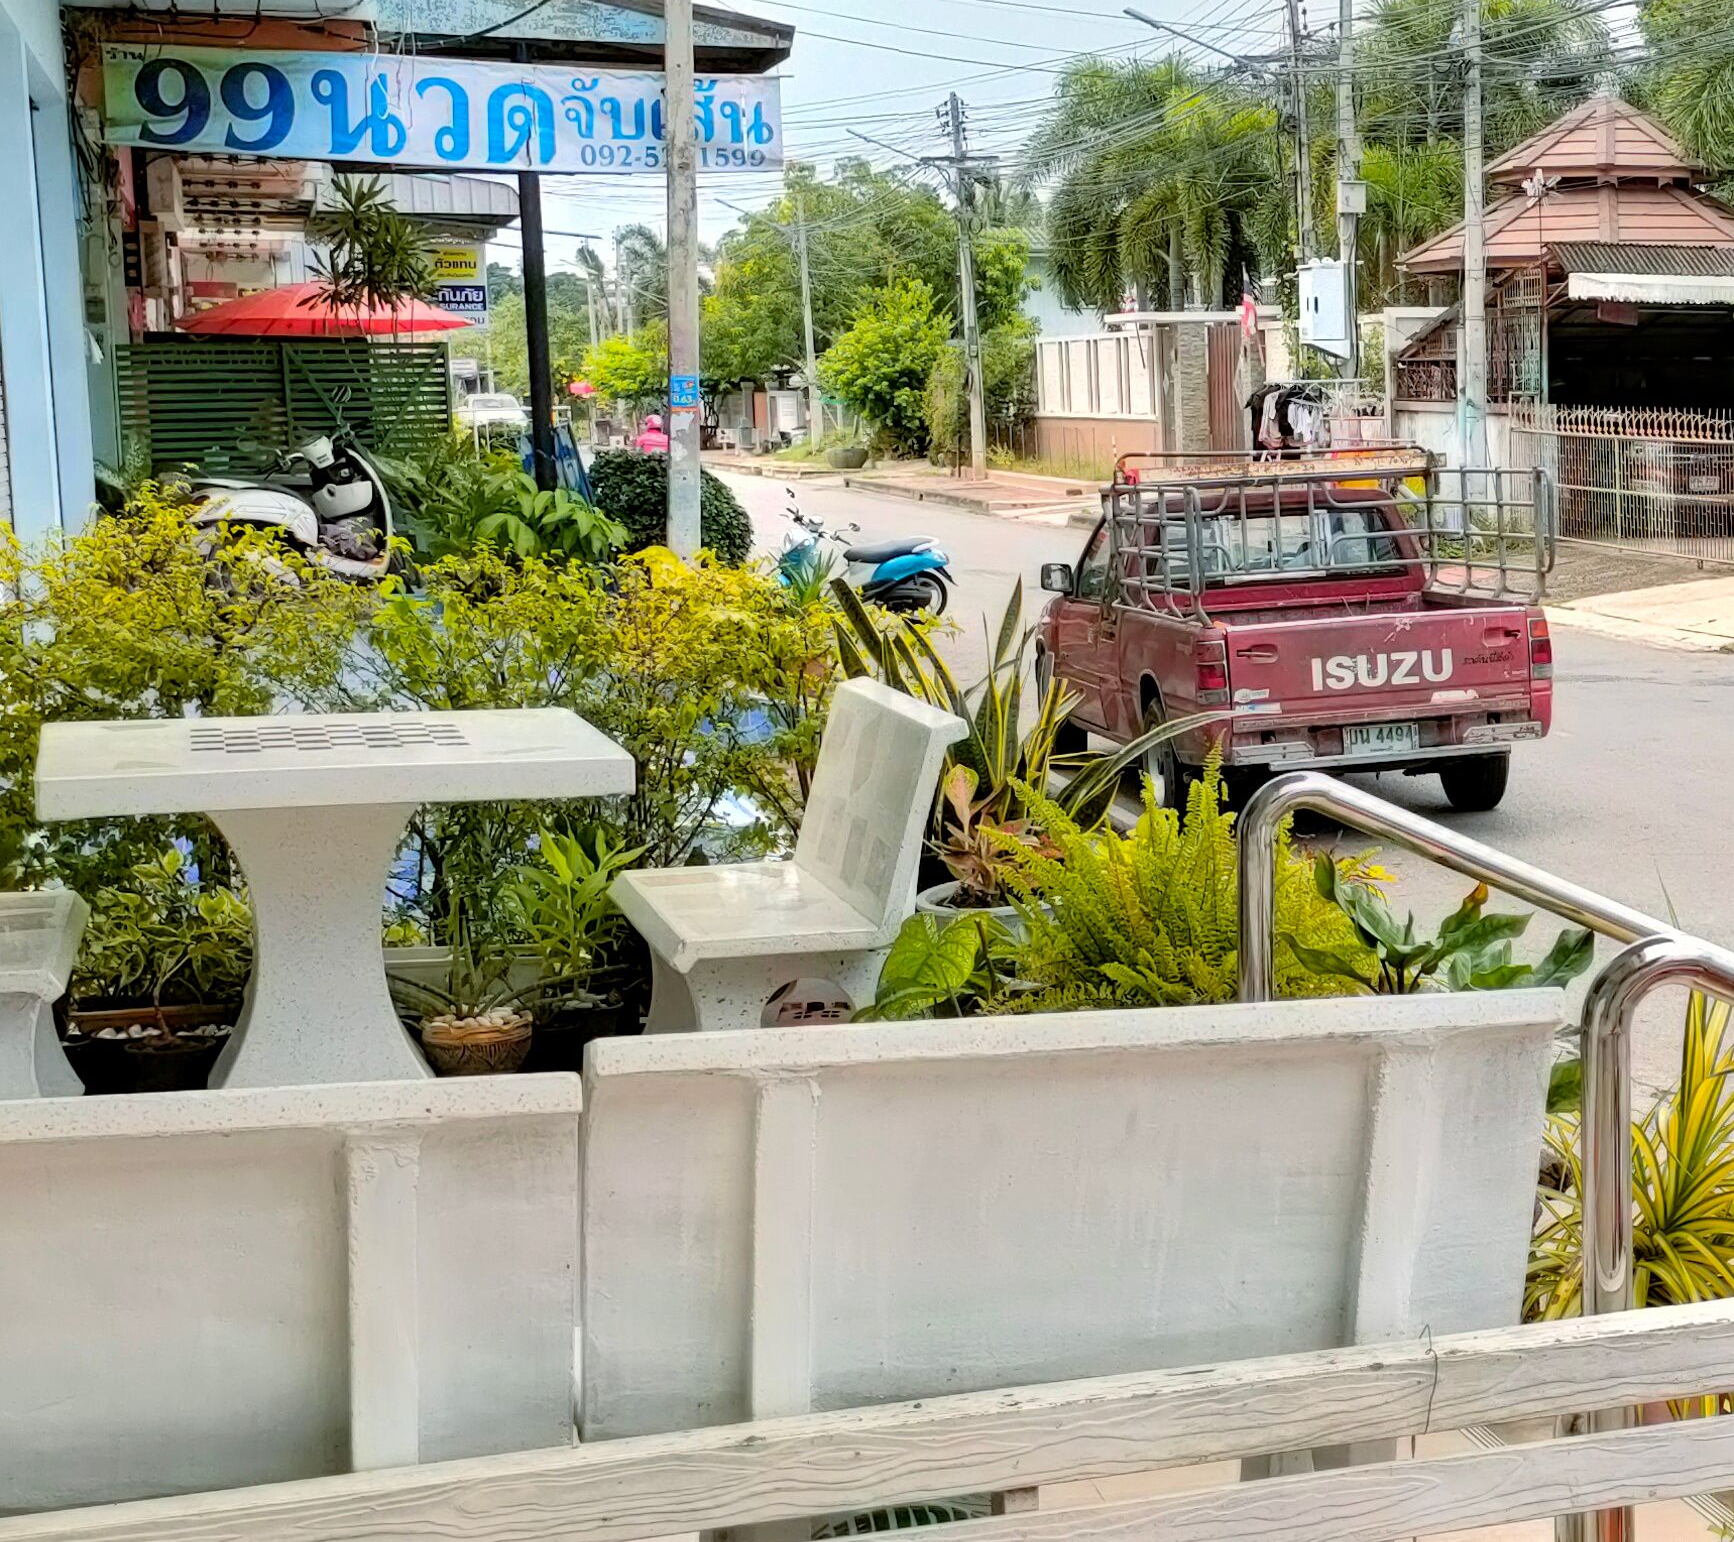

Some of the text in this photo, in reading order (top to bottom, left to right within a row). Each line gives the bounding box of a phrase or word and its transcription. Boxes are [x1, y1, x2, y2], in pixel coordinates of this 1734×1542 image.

[580, 144, 767, 167] 092-51599
[438, 288, 484, 302] กันภัย
[439, 302, 484, 311] SURANCE
[1311, 647, 1454, 692] ISUZU
